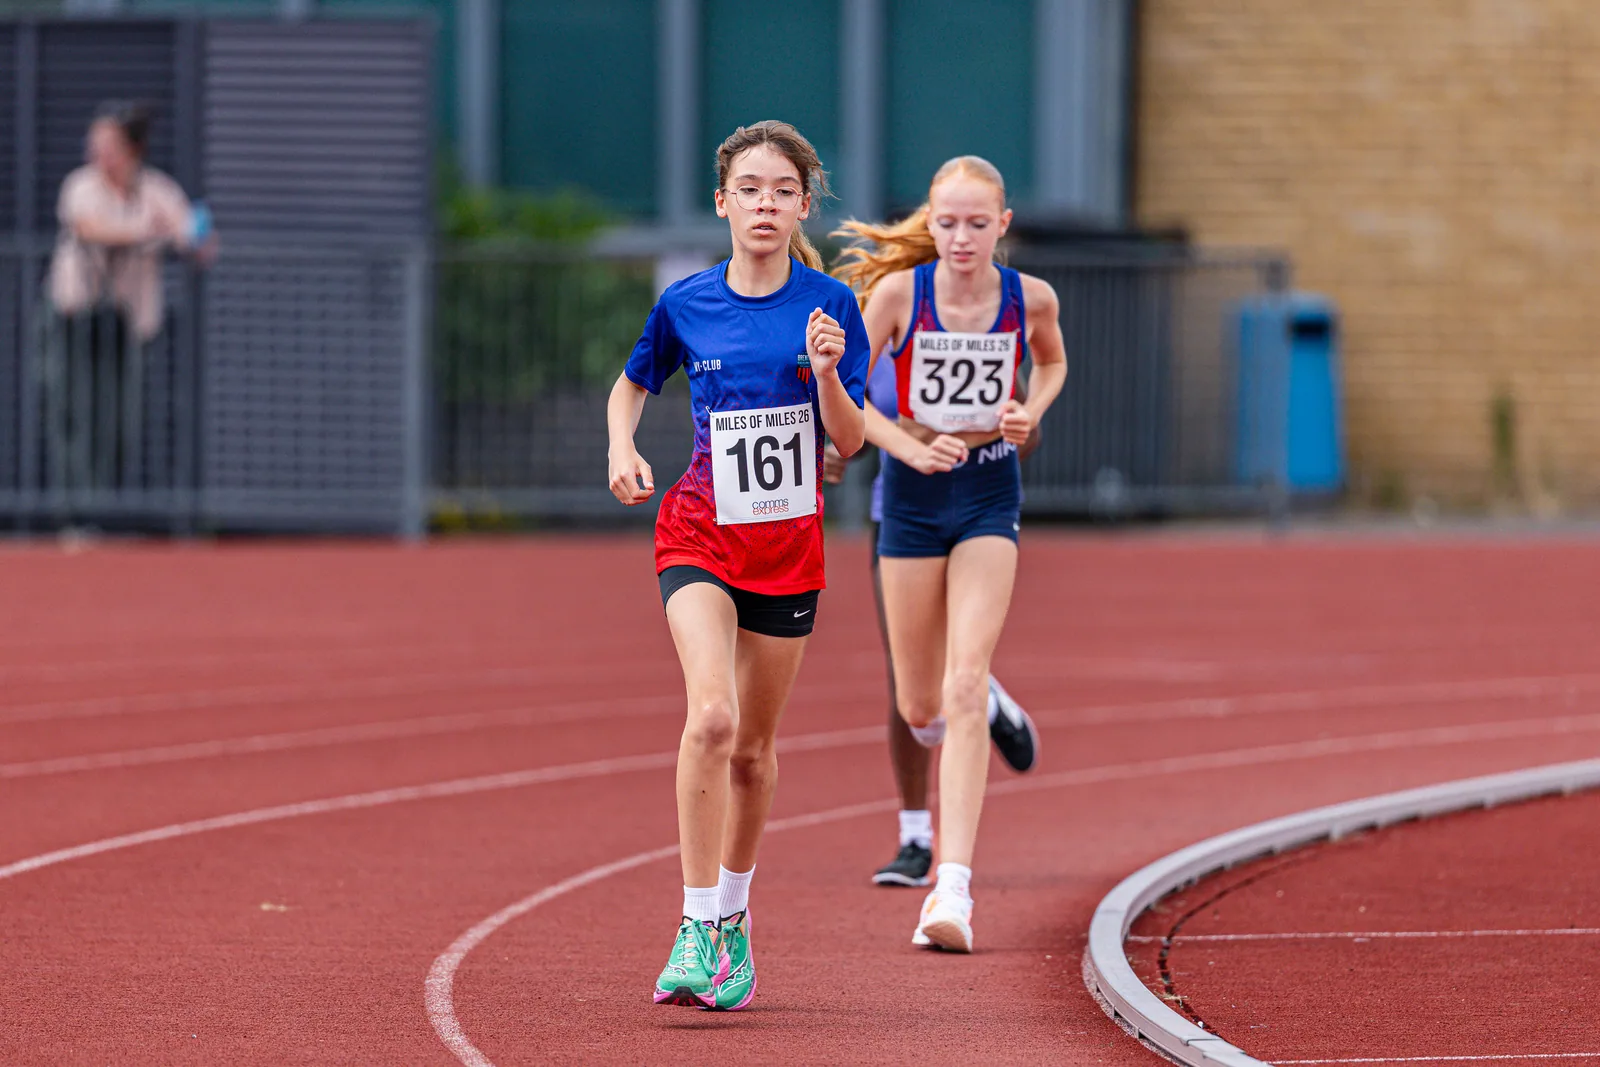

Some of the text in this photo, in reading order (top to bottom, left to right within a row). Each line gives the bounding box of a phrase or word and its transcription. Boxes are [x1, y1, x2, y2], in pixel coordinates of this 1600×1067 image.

[920, 338, 949, 351] MILES
[951, 338, 963, 351] OF
[966, 339, 996, 352] MILES
[920, 358, 1004, 406] 323
[715, 408, 810, 431] MILES OF MILES 26
[726, 432, 803, 492] 161
[751, 498, 789, 509] comms
[752, 504, 789, 516] express
